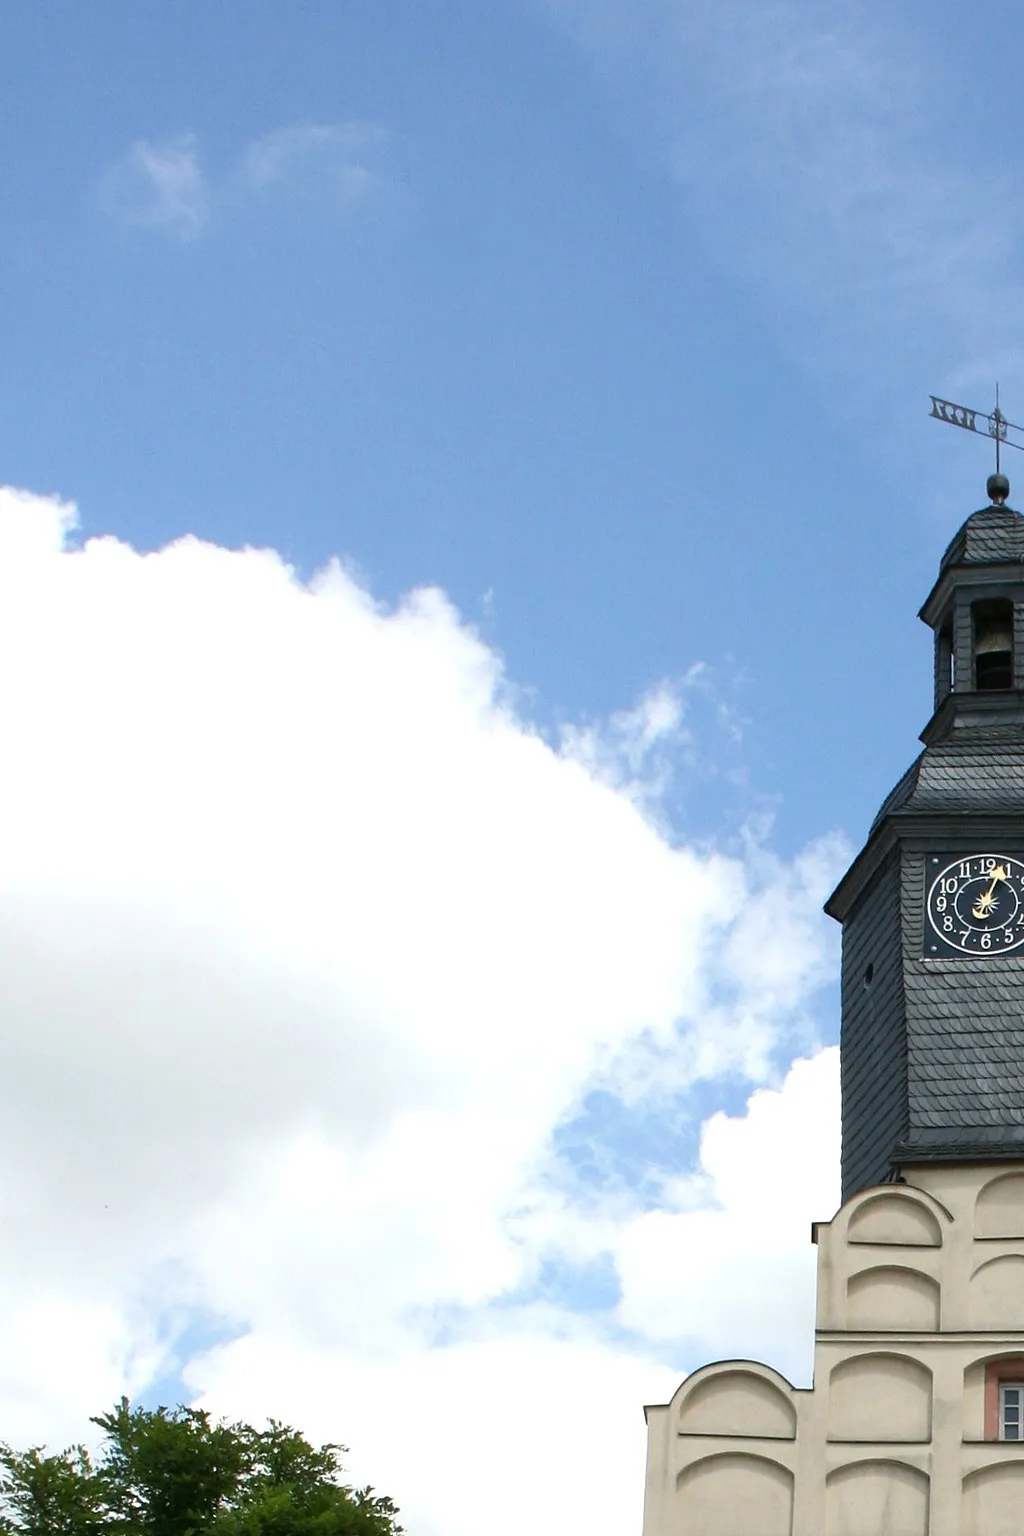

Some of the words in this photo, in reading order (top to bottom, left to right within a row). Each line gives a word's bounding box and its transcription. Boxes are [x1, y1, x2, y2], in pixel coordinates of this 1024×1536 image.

[959, 862, 971, 878] 11
[1005, 863, 1013, 878] 1
[939, 877, 958, 894] 10
[936, 896, 947, 912] 9
[943, 916, 953, 931] 8
[959, 930, 971, 947] 7
[980, 933, 992, 950] 6
[1004, 928, 1014, 944] 5
